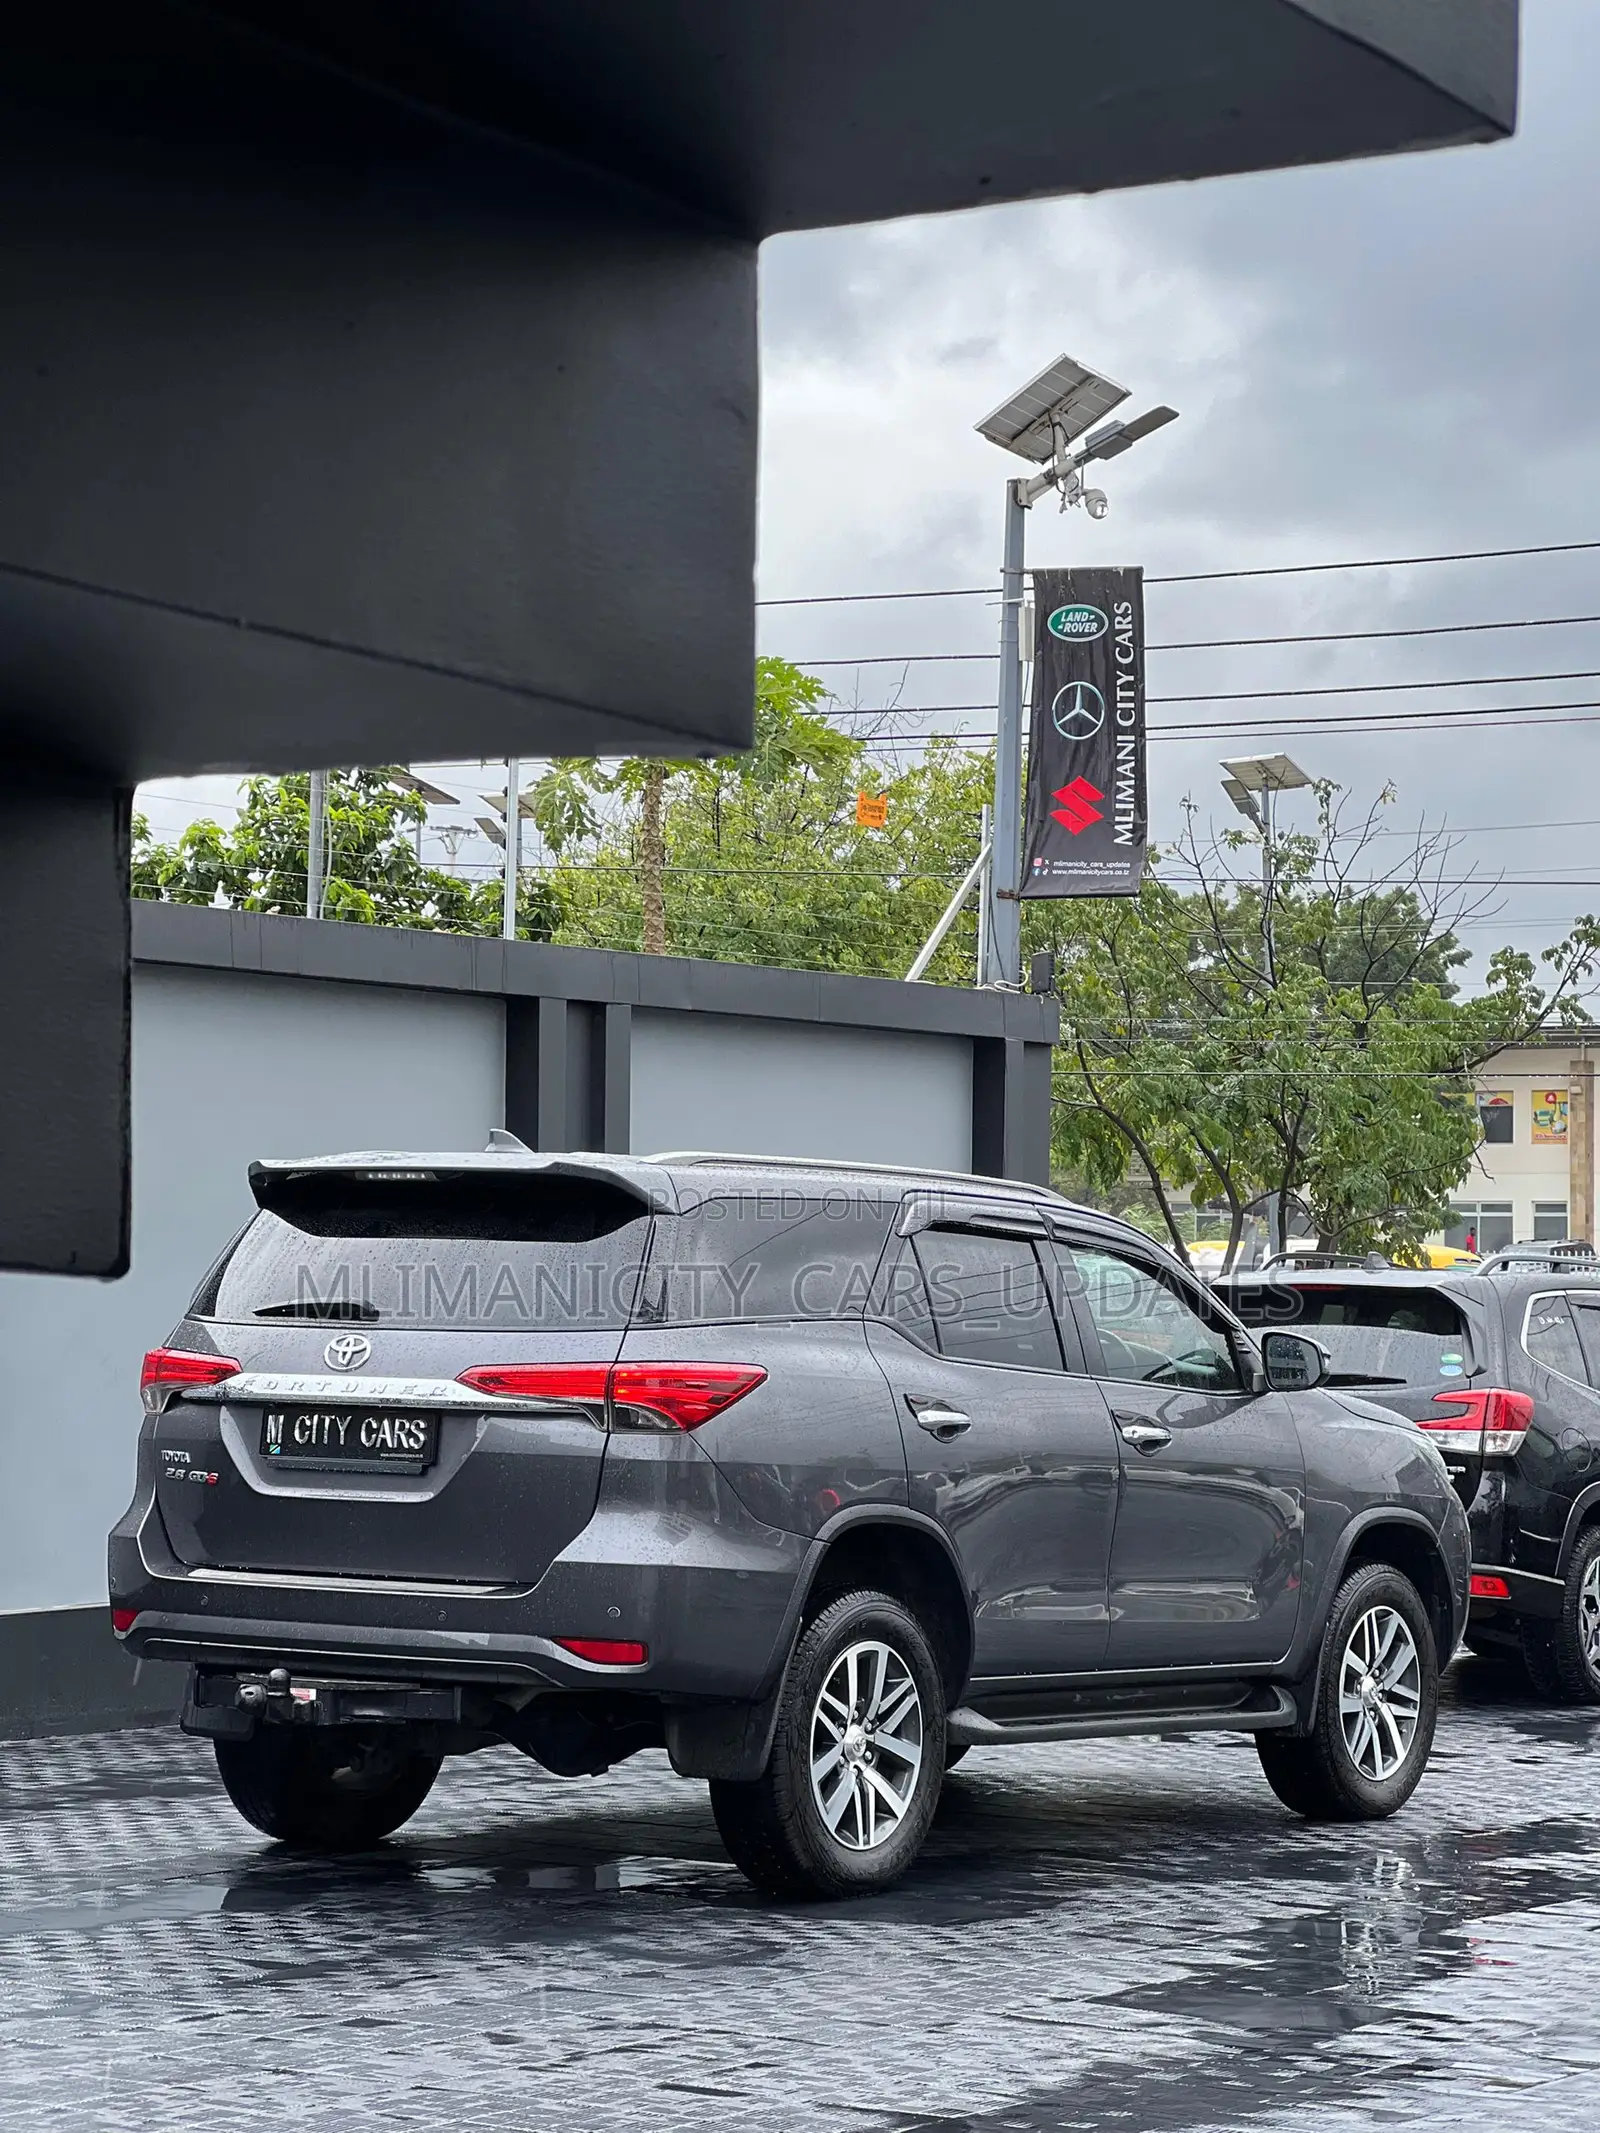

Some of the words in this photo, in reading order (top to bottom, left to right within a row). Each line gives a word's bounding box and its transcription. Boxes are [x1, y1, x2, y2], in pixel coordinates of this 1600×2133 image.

[1061, 612, 1089, 622] LAND
[1063, 622, 1098, 633] ROVER
[1113, 601, 1134, 664] CARS
[1116, 670, 1136, 727] CITY
[1113, 735, 1136, 846] MLIMANI
[241, 1376, 450, 1397] FORTUNER
[265, 1413, 285, 1444] M
[293, 1413, 353, 1446] CITY
[360, 1416, 428, 1450] CARS
[161, 1450, 191, 1463] TOYOTA
